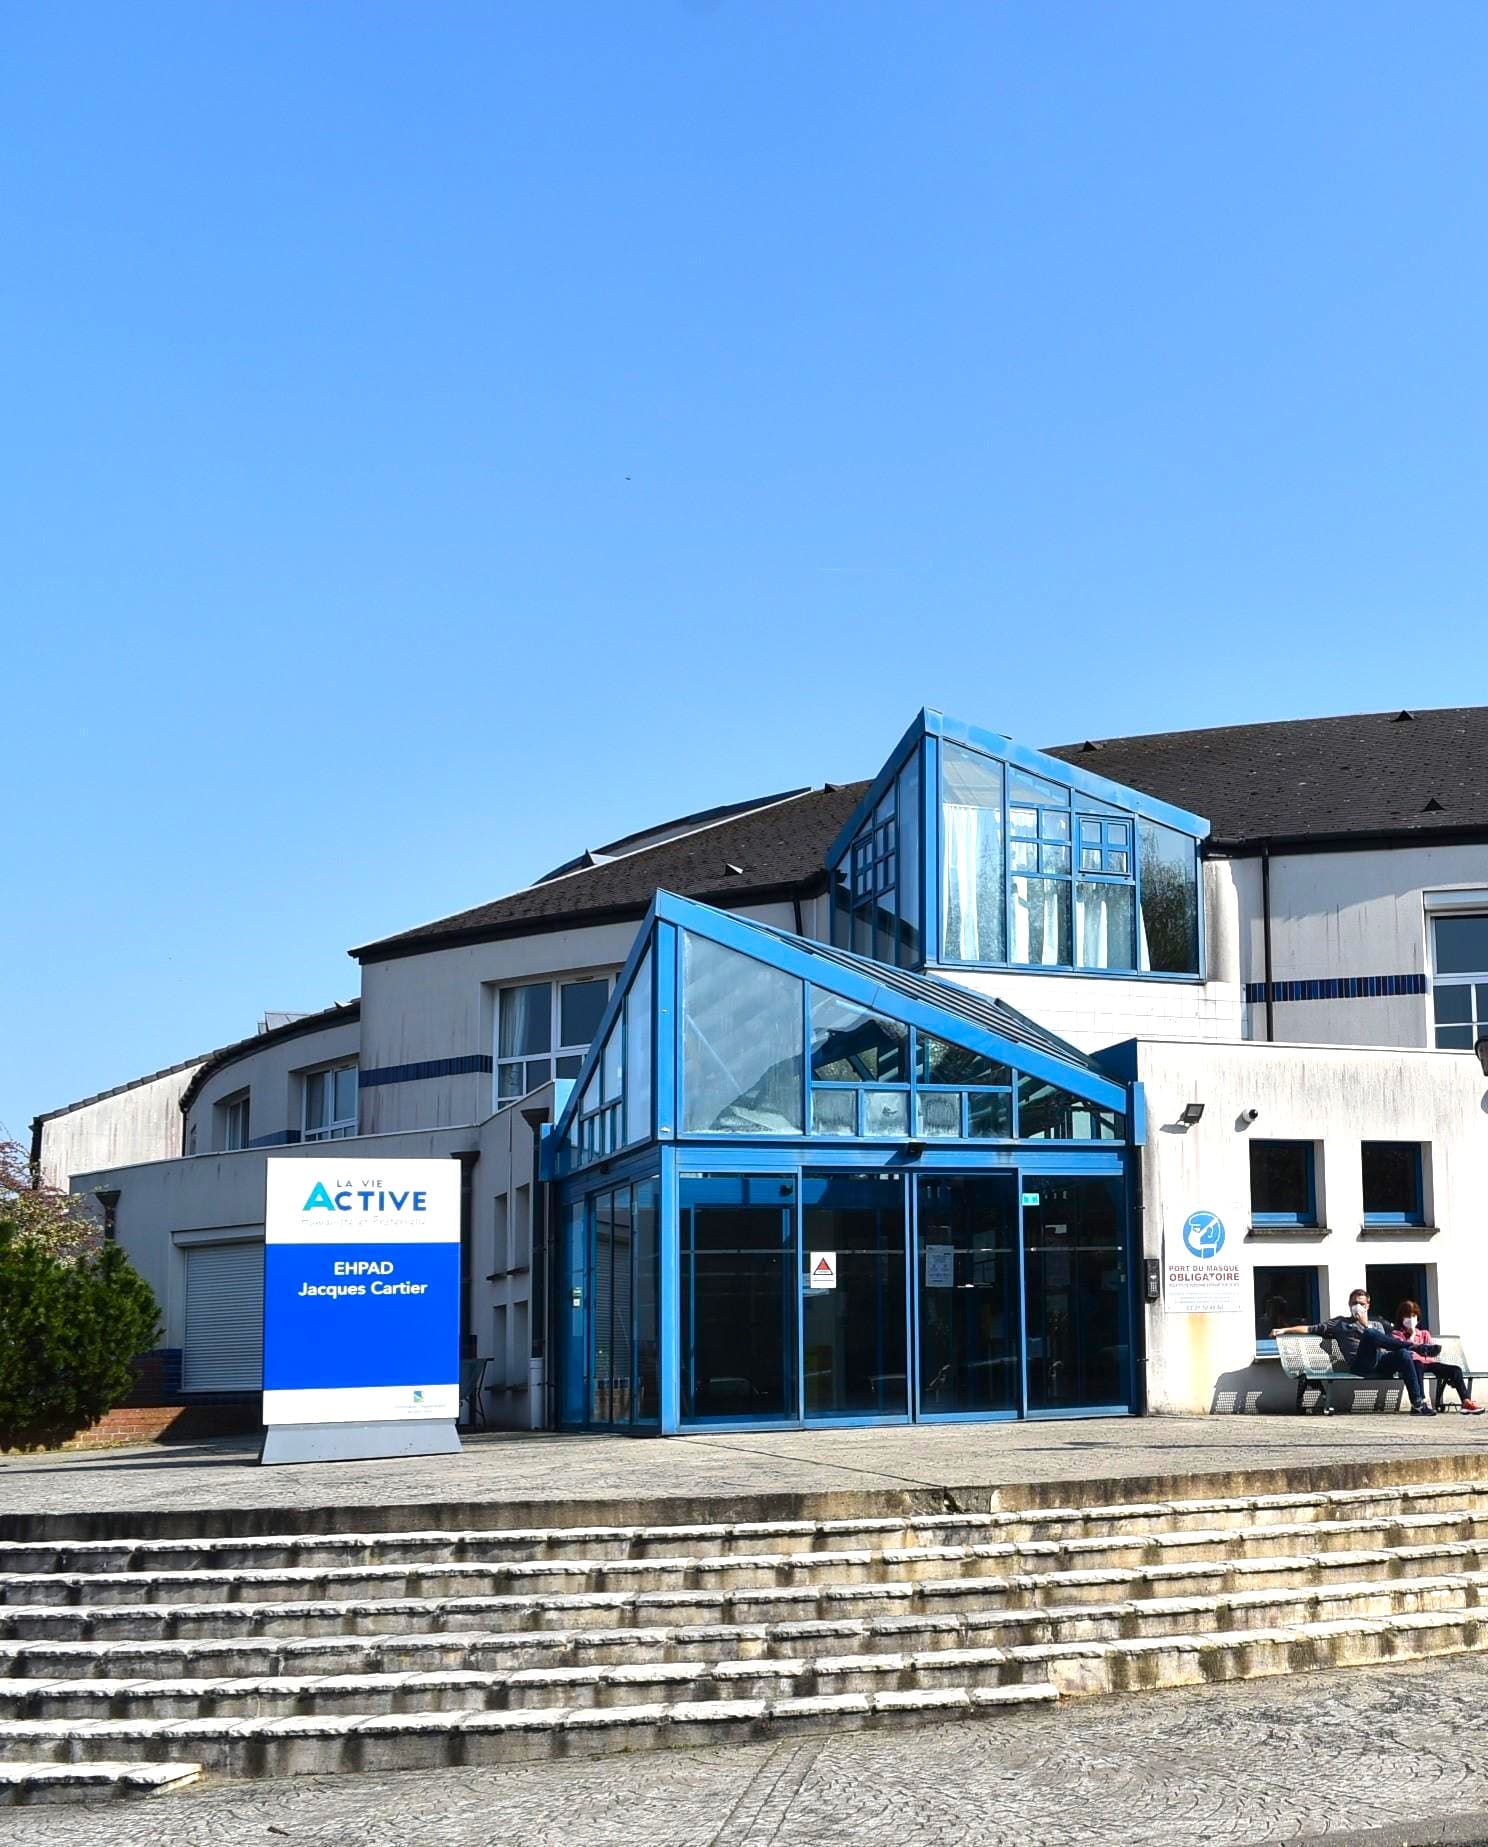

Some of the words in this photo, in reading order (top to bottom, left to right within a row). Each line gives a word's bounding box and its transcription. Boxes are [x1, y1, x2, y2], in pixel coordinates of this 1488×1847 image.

[336, 1179, 353, 1188] LA
[361, 1179, 383, 1188] VIE
[302, 1181, 427, 1212] ACTIVE
[333, 1261, 394, 1276] EHPAD
[1169, 1272, 1240, 1282] OBLIGATOIRE
[297, 1282, 367, 1300] Jacques
[370, 1280, 428, 1295] Cartier
